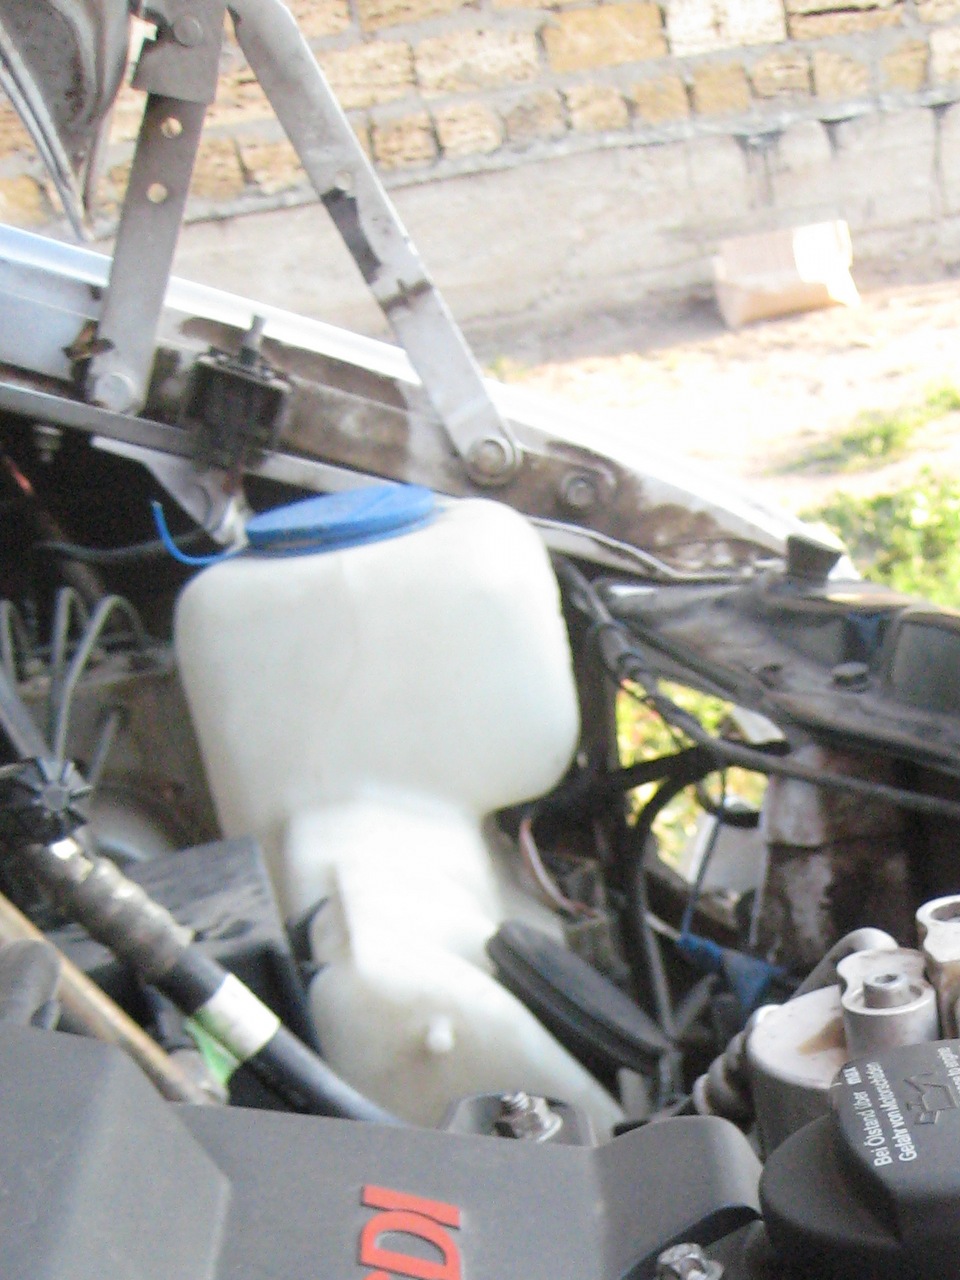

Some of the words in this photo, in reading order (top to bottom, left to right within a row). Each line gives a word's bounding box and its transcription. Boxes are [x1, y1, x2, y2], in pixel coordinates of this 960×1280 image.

[856, 1109, 885, 1147] Ölstand
[887, 1109, 905, 1128] von
[870, 1146, 893, 1167] Bei
[892, 1128, 917, 1161] Gefahr
